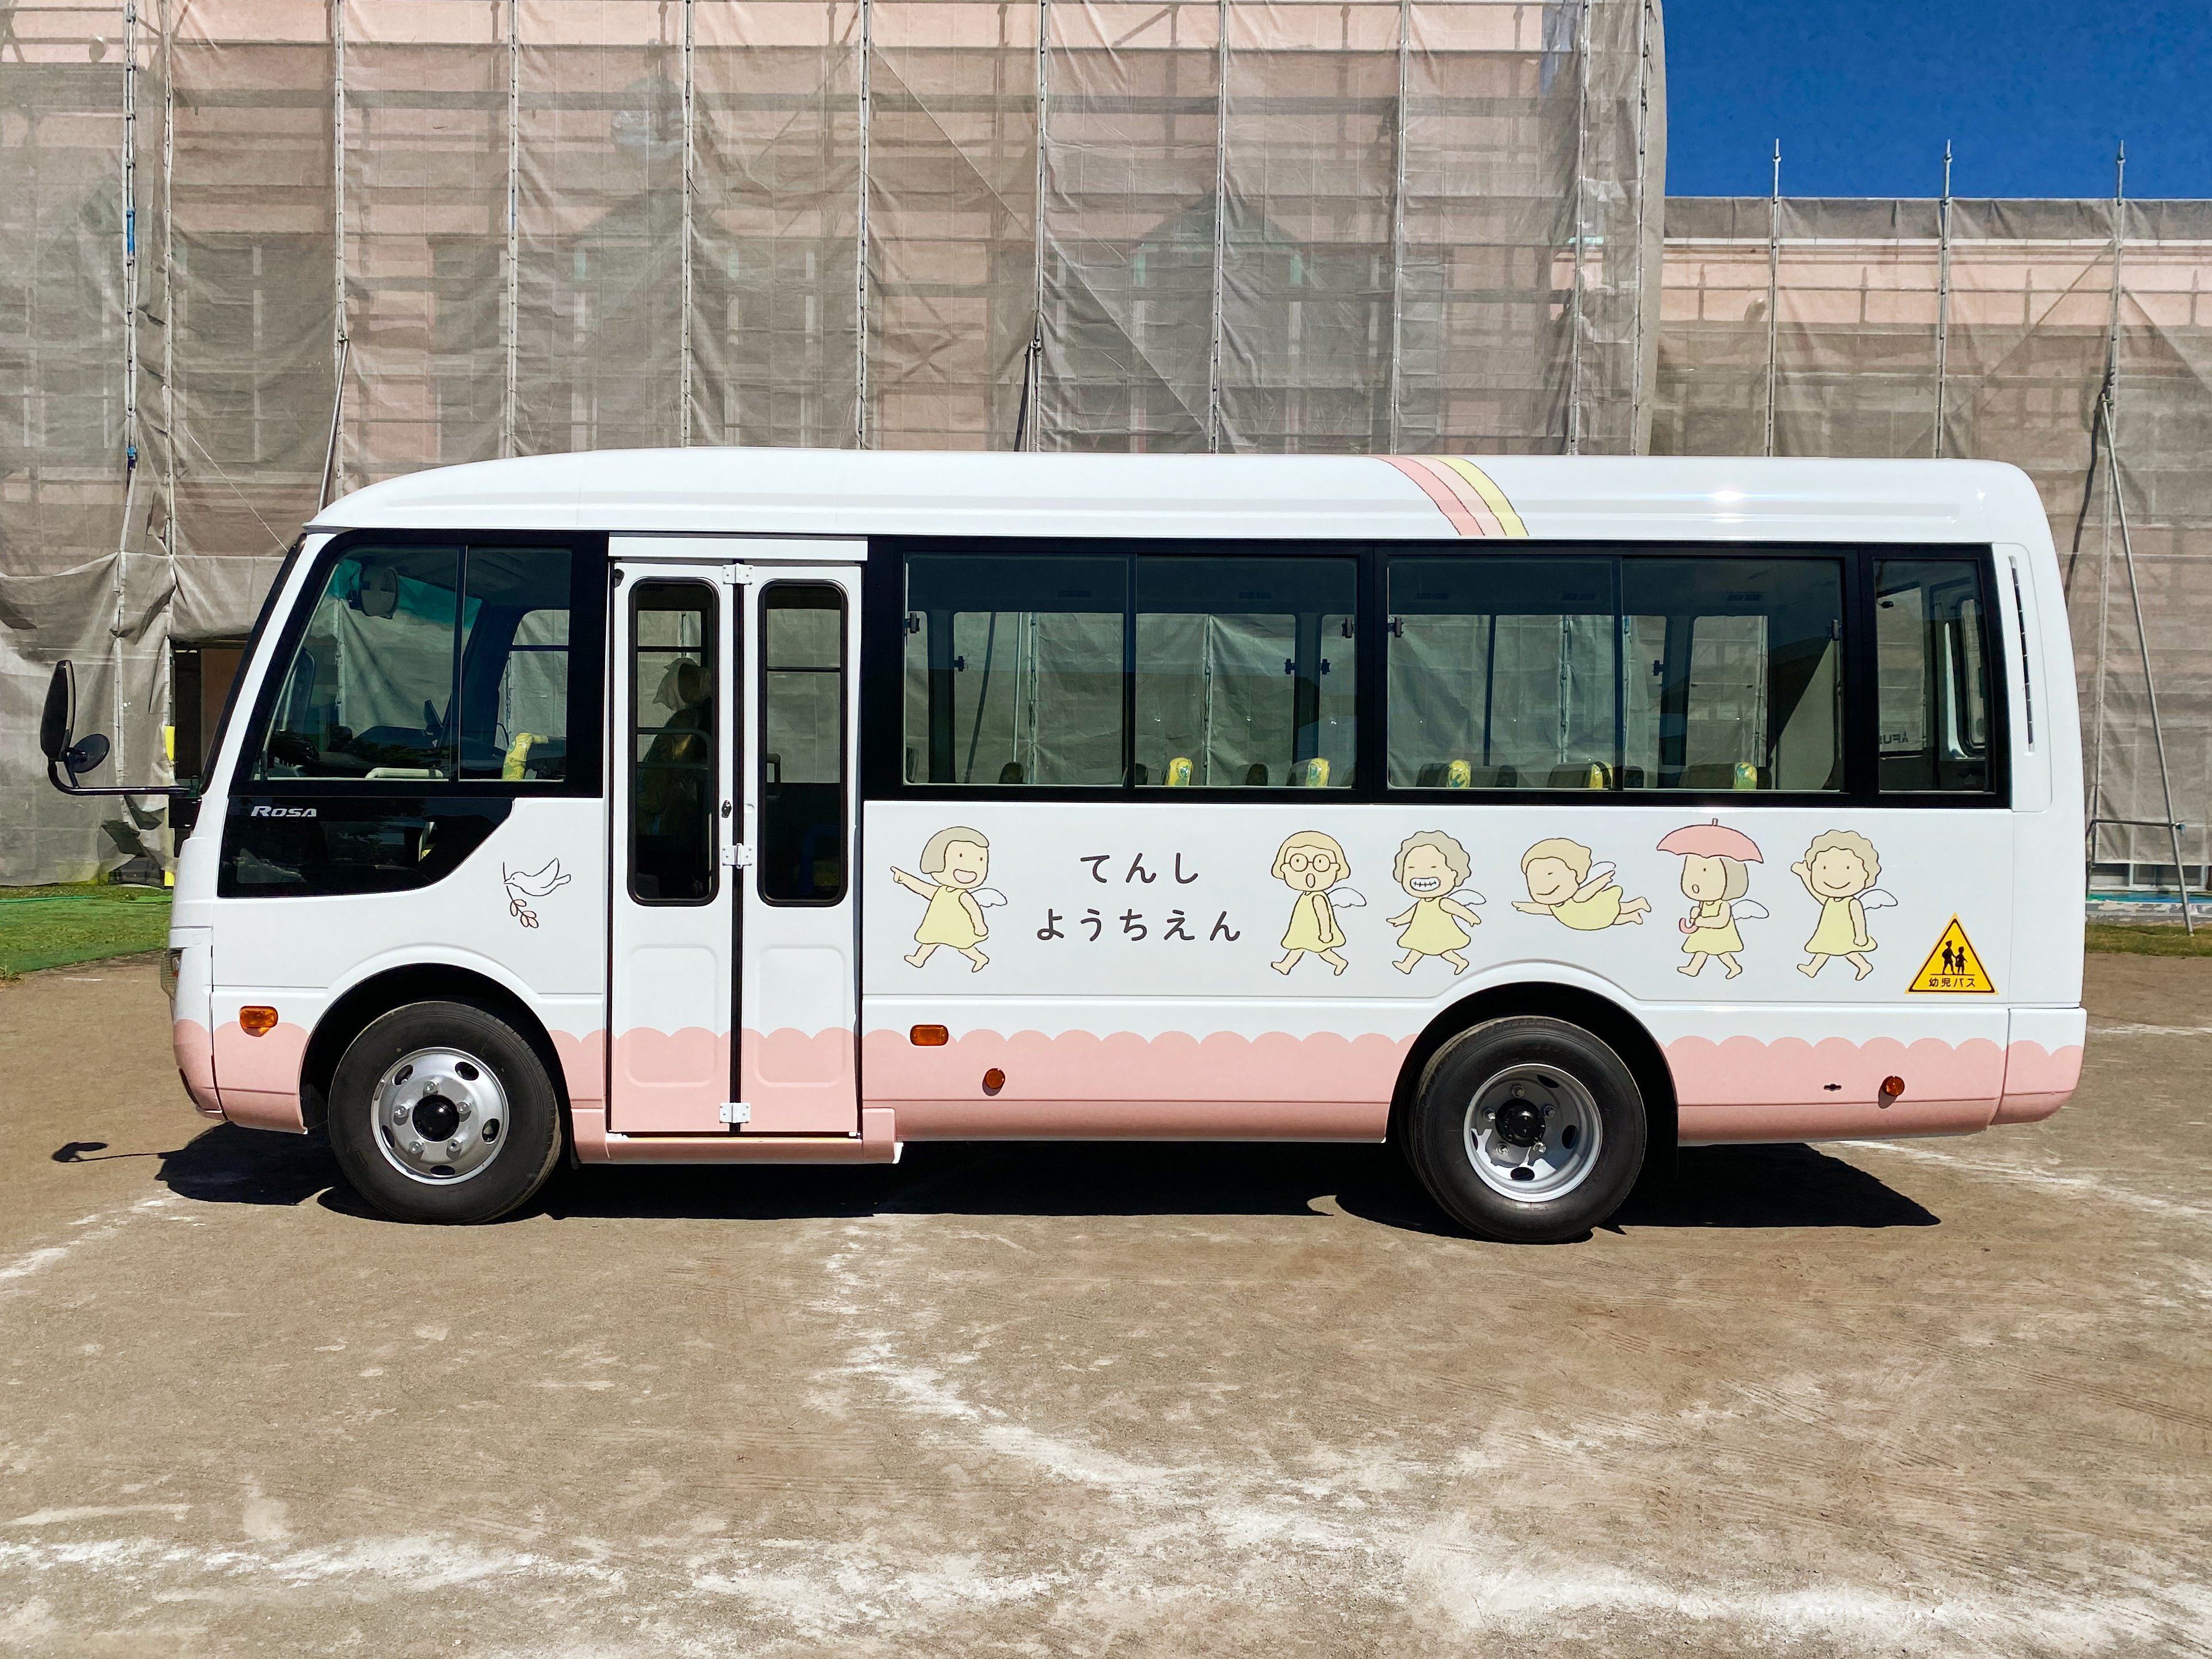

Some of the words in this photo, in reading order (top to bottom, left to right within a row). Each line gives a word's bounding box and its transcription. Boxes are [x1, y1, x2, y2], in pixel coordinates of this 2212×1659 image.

[1080, 852, 1198, 884] てんし
[1037, 908, 1240, 941] ようちえん
[1929, 977, 1976, 988] 幼児バス
